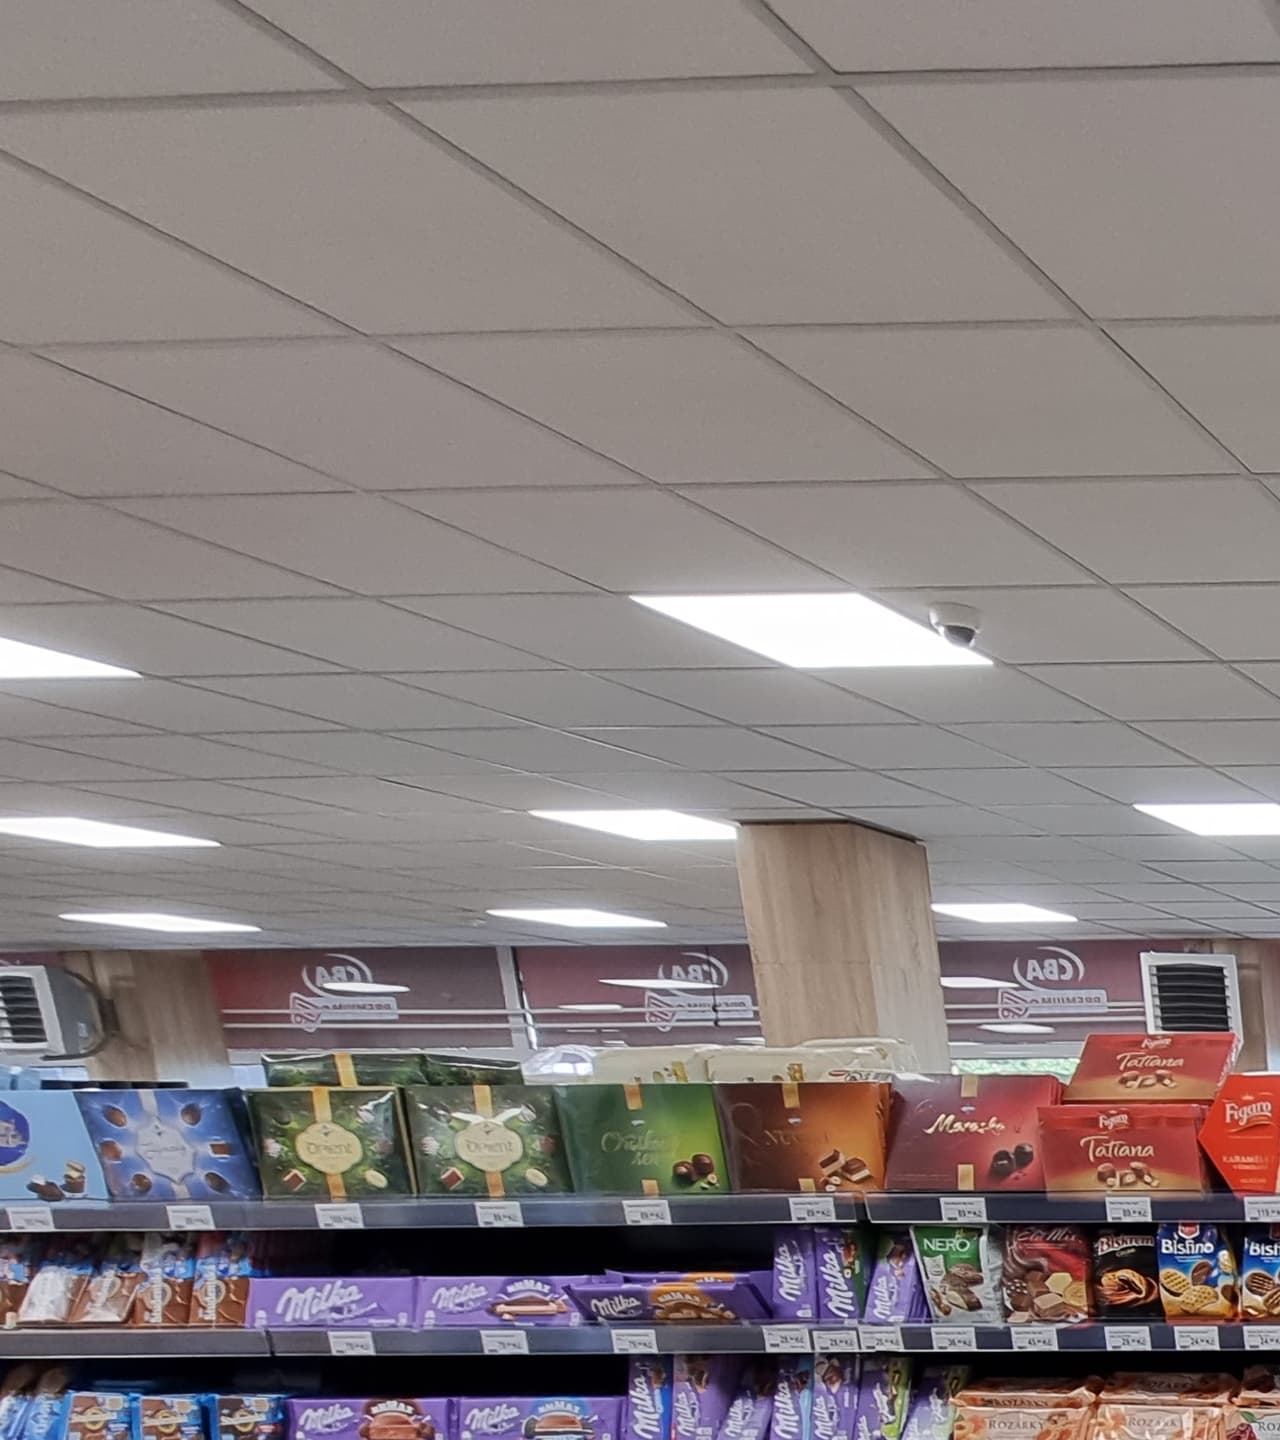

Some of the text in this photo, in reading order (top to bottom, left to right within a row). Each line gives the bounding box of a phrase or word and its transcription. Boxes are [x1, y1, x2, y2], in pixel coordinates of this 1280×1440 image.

[1116, 1052, 1184, 1070] Tatiana
[1098, 1112, 1130, 1130] Figaro
[1225, 1099, 1272, 1126] Figaro
[1080, 1135, 1155, 1158] Tatiana
[922, 1237, 970, 1252] NERO
[777, 1243, 796, 1301] Milka
[826, 1249, 853, 1318] Milka
[277, 1280, 363, 1322] Milka
[432, 1283, 488, 1307] Milka
[590, 1297, 641, 1316] Milka
[872, 1275, 893, 1320] Milka
[304, 1404, 353, 1430] Milka
[466, 1403, 519, 1431] Milka
[632, 1376, 660, 1438] Milka
[677, 1393, 698, 1437] Milka
[775, 1379, 795, 1439] Milka
[814, 1397, 834, 1440] Milka
